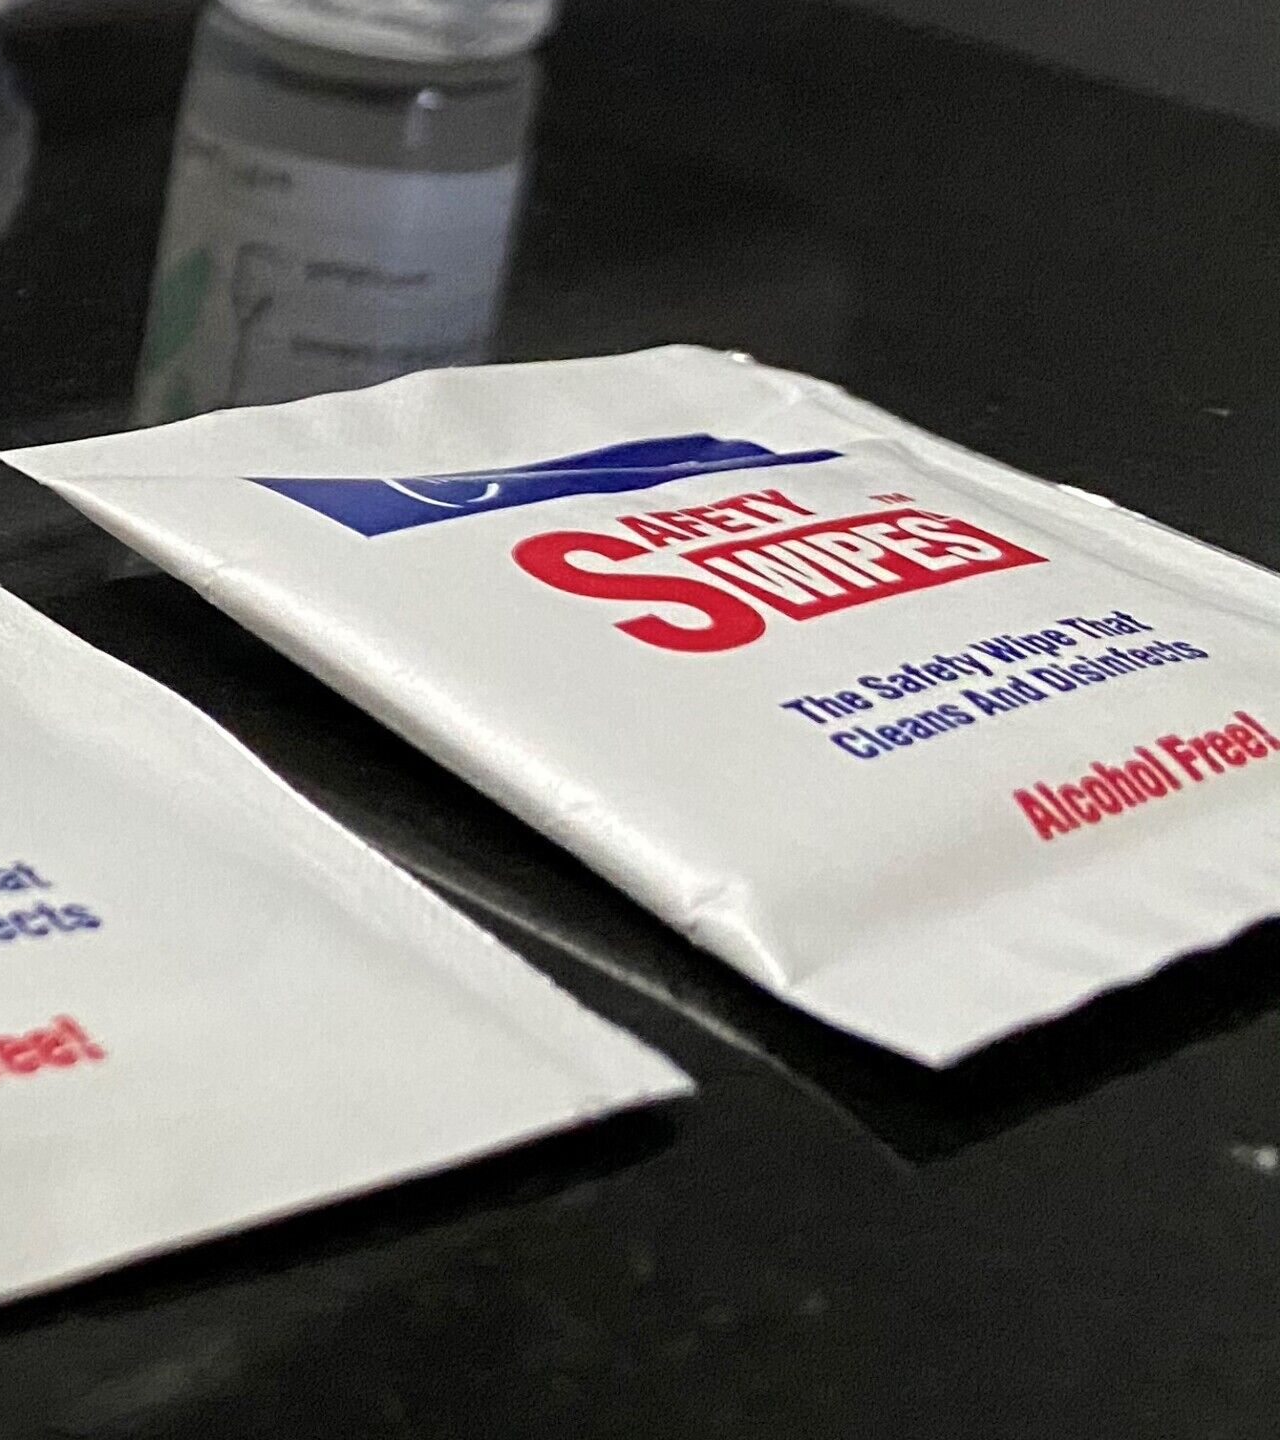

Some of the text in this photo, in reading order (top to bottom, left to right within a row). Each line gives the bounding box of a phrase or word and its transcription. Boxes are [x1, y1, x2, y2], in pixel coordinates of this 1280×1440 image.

[512, 489, 817, 654] SAFETY
[702, 515, 1006, 608] WIPES
[780, 609, 1154, 725] The Safety Wipe That
[831, 638, 1209, 760] Cleans And Disinfects
[1013, 709, 1280, 841] Alcohol Free!
